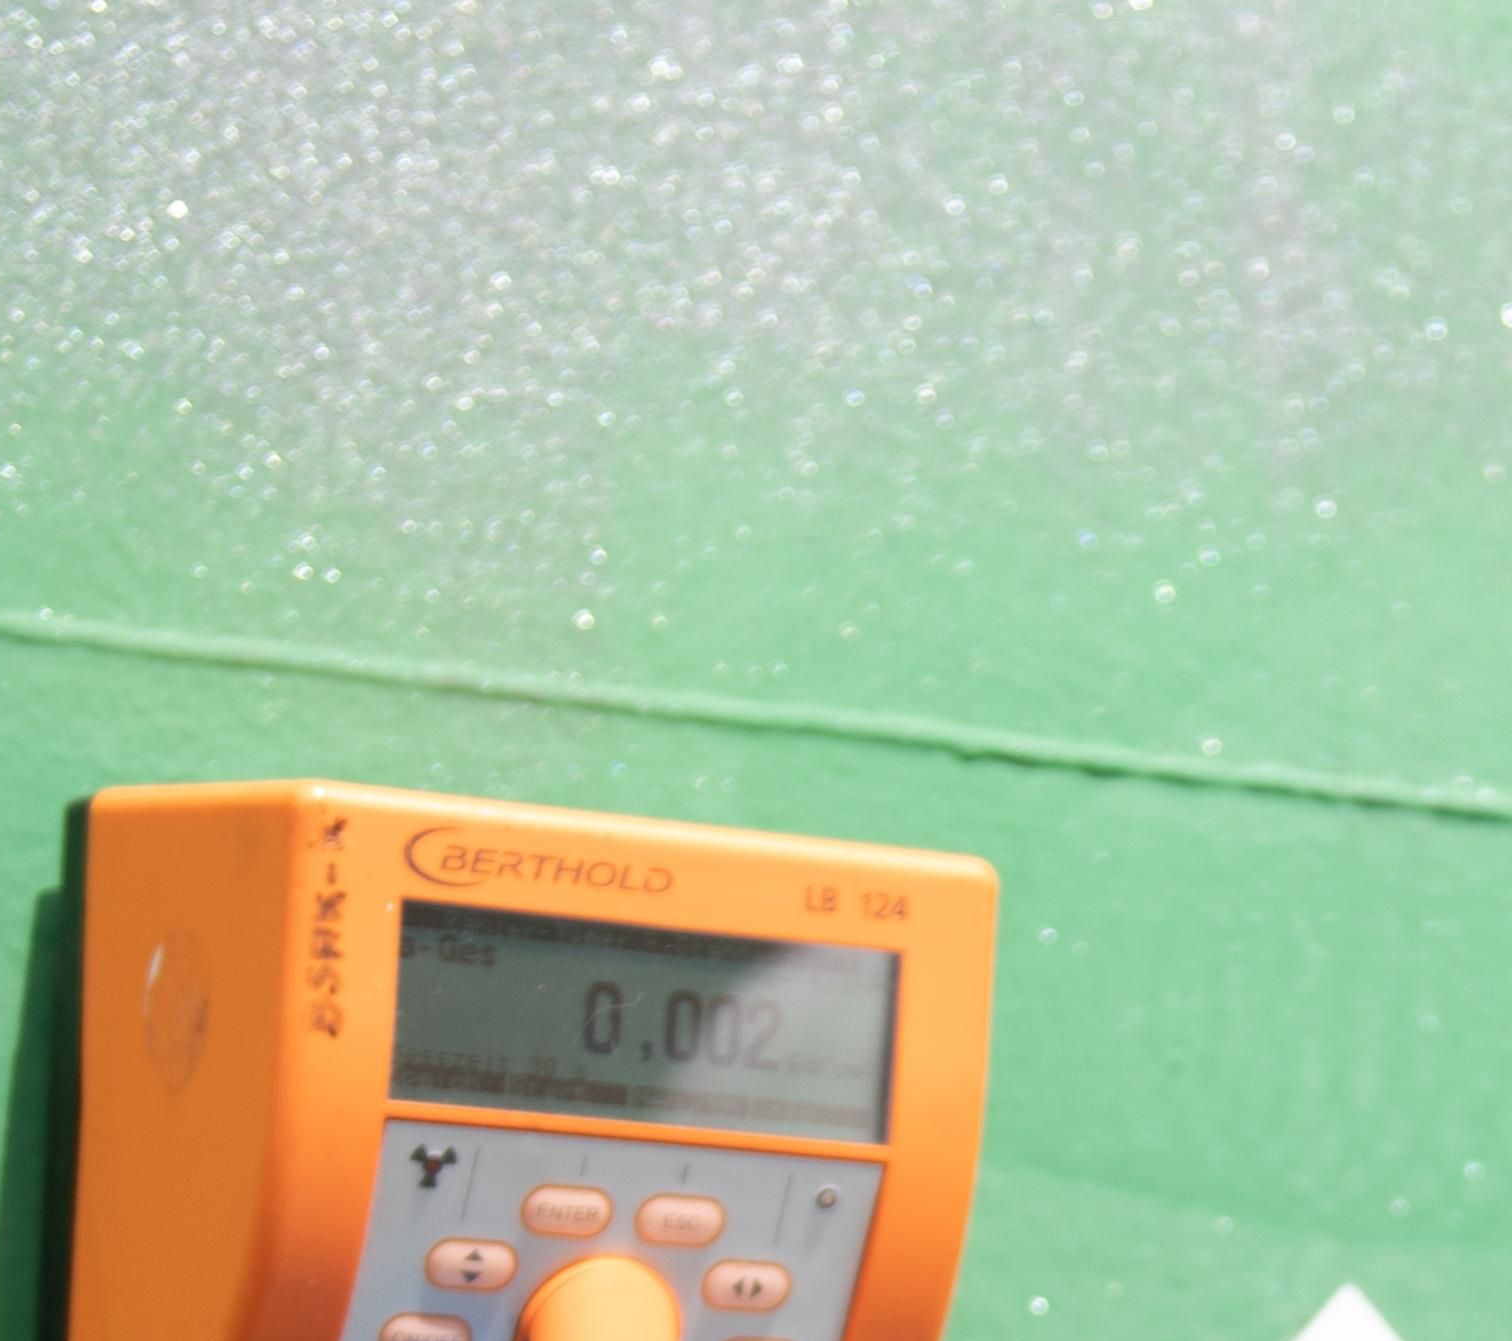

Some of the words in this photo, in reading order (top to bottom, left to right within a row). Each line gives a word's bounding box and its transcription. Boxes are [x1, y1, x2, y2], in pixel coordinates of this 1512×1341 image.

[438, 843, 676, 894] BERTHOLD
[805, 885, 838, 913] LB
[862, 890, 908, 922] 124
[537, 1202, 600, 1223] ENTER
